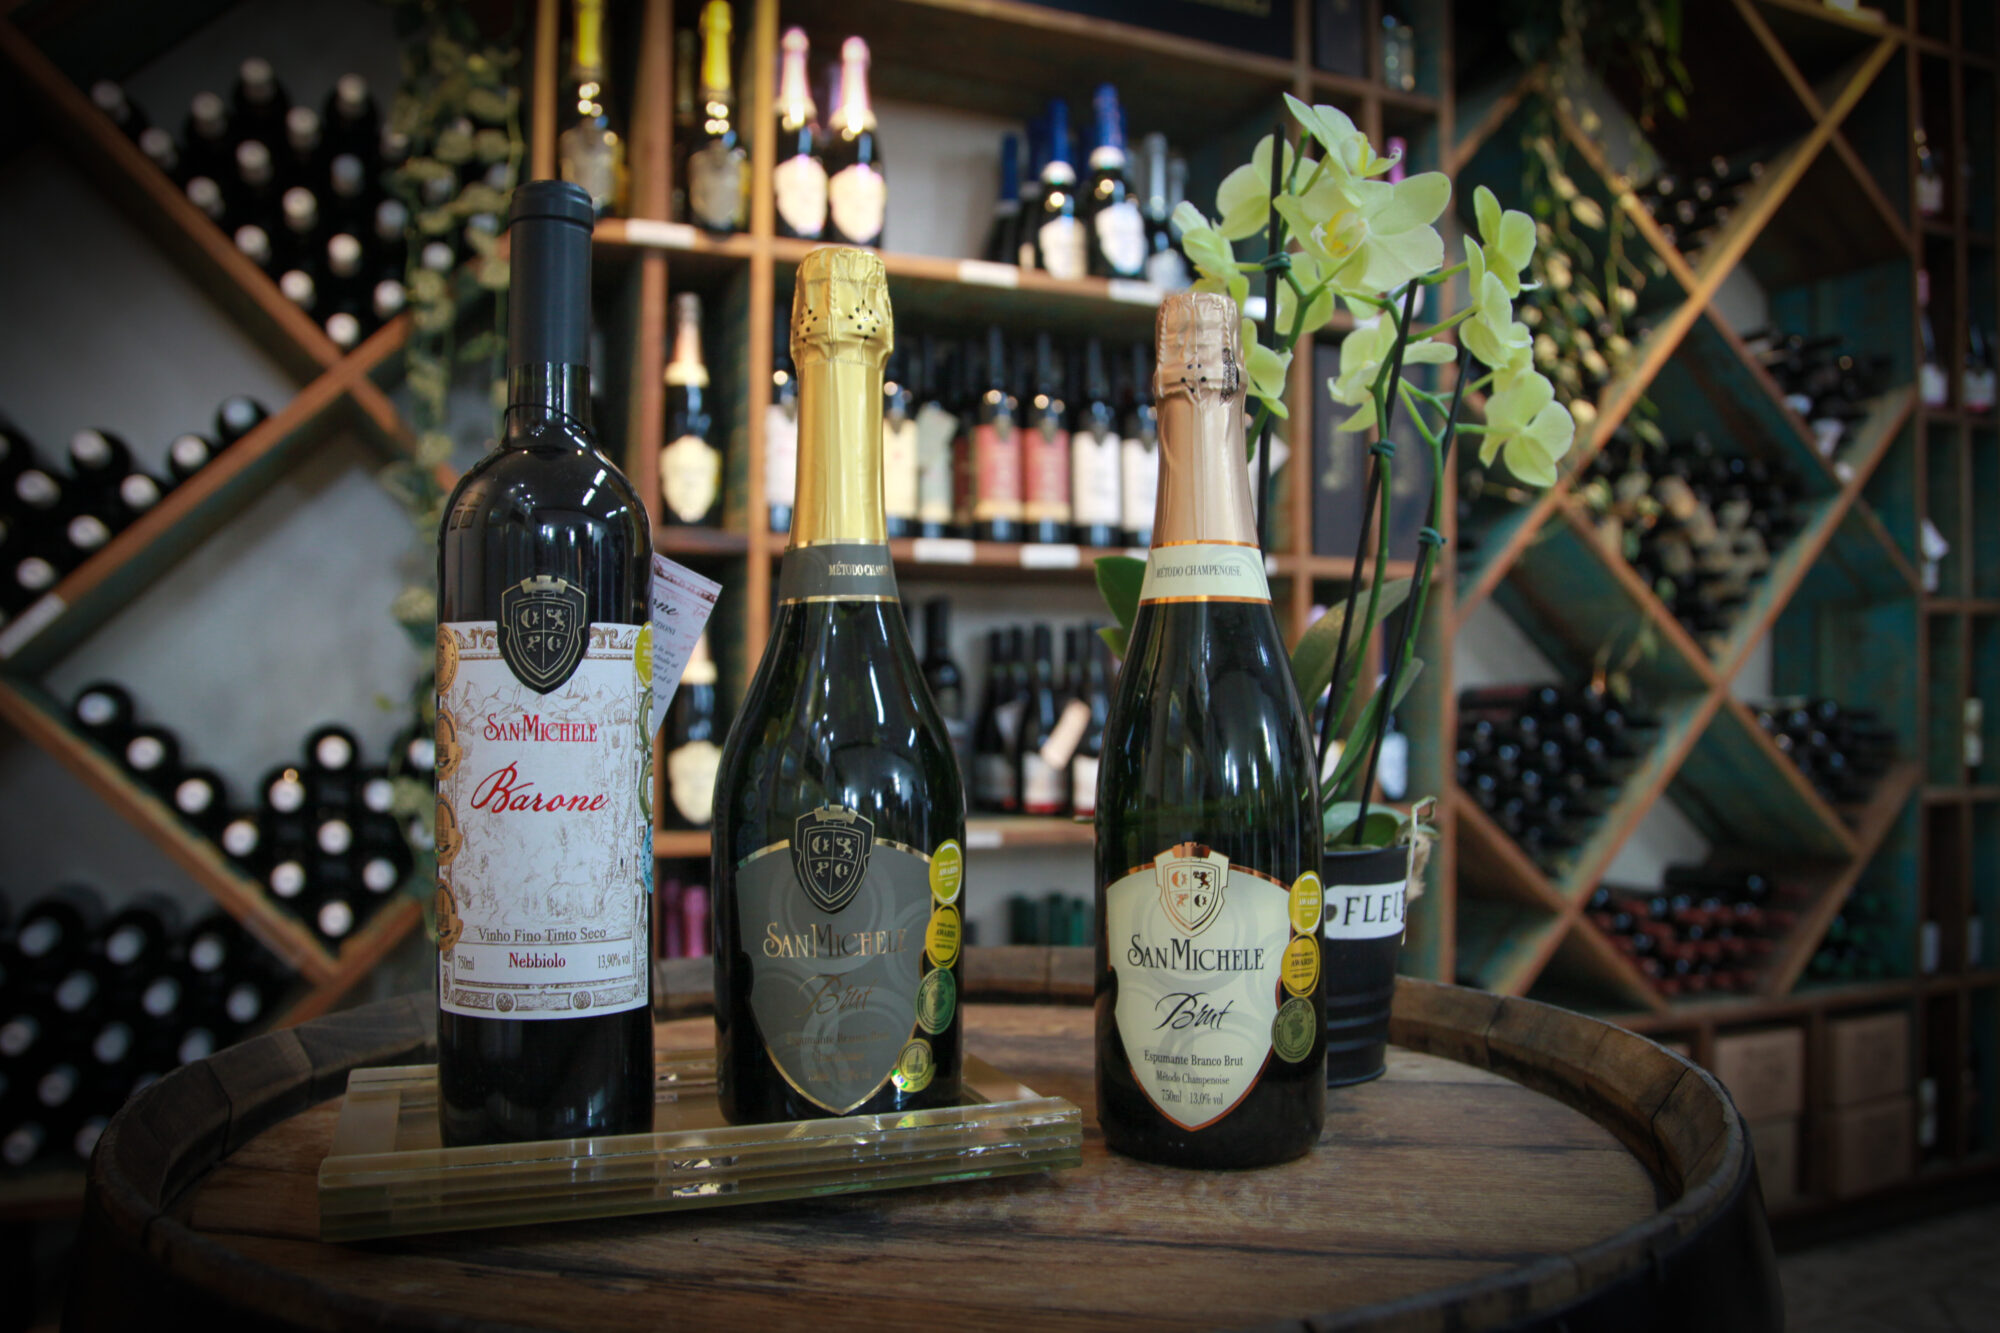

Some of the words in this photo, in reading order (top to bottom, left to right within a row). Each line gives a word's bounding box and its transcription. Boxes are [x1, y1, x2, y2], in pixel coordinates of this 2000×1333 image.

[1156, 563, 1184, 579] MÉTODO
[1184, 564, 1242, 578] CHAMPENOISE
[471, 760, 610, 814] Barone
[478, 927, 512, 943] Vinho
[513, 928, 542, 942] Fino
[544, 927, 577, 942] Tinto
[580, 926, 607, 941] Seco
[457, 954, 475, 971] 750ml
[507, 951, 567, 969] Nebbiolo
[1152, 991, 1235, 1031] Brut
[1143, 1049, 1189, 1066] Espumante
[1190, 1054, 1222, 1067] Branco
[1223, 1054, 1244, 1067] Brut
[1181, 1072, 1231, 1088] Champenoise
[1161, 1088, 1182, 1104] 750ml
